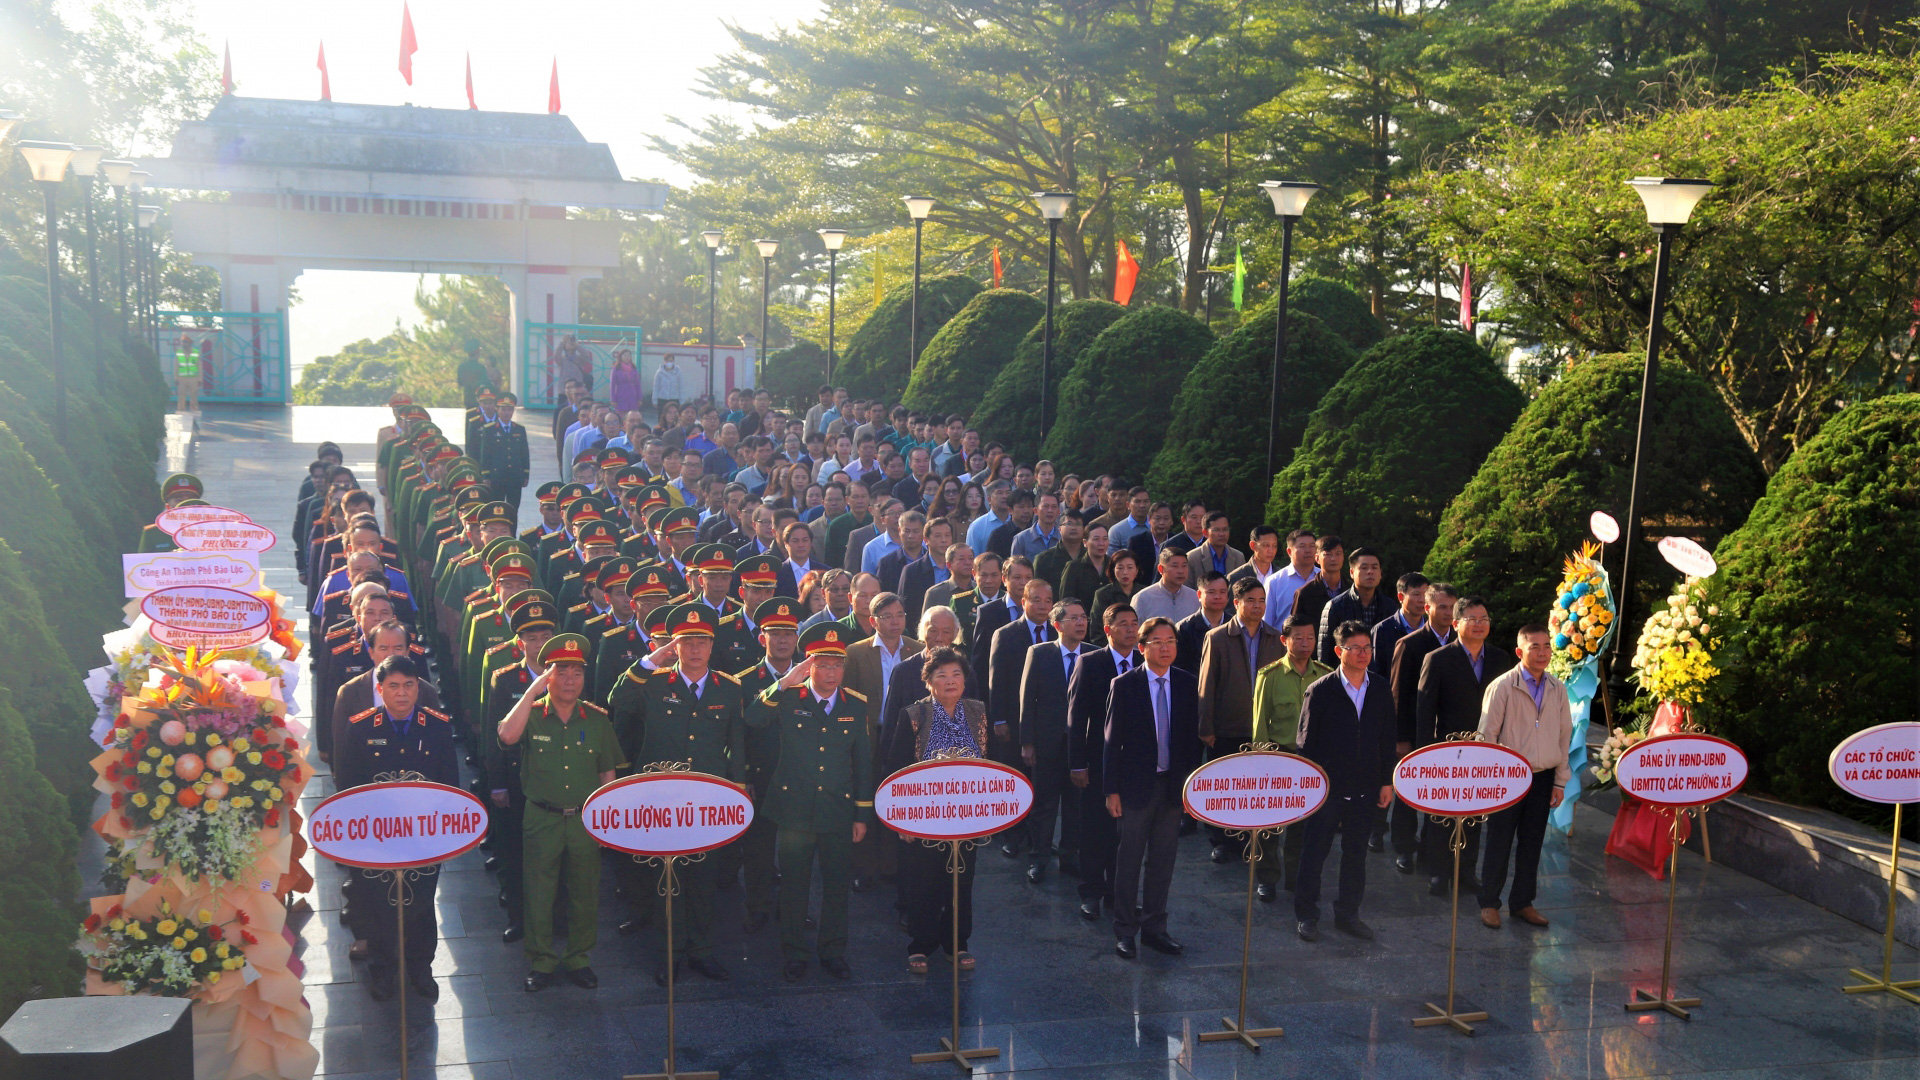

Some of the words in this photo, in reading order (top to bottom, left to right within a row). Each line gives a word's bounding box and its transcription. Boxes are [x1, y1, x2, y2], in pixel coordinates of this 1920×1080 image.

[240, 540, 248, 548] 2
[140, 568, 159, 578] Công
[1640, 749, 1662, 768] ĐẢNG
[1666, 749, 1676, 767] ỦY
[1679, 753, 1726, 766] HĐND-UBND
[1845, 750, 1865, 763] CÁC
[1870, 747, 1884, 762] TỔ
[1886, 748, 1915, 761] CHỨC
[1400, 764, 1417, 778] CÁC
[1420, 763, 1449, 778] PHÒNG
[1452, 766, 1469, 778] BAN
[1472, 763, 1504, 778] CHUYÊN
[1508, 763, 1527, 778] MÔN
[1845, 768, 1858, 780] VÀ
[1862, 767, 1882, 780] CÁC
[1886, 769, 1920, 779] DOANH
[892, 782, 943, 797] BMVNAH-LTCM
[946, 778, 959, 794] CÁC
[962, 781, 975, 794] Đ/C
[978, 777, 986, 793] LÀ
[989, 776, 1003, 793] CÁN
[1006, 775, 1015, 796] BỘ
[1193, 777, 1211, 791] LÃNH
[1214, 778, 1229, 794] ĐẠO
[1232, 774, 1256, 790] THÀNH
[1271, 777, 1292, 789] HĐND
[1300, 776, 1320, 789] UBND
[1632, 776, 1665, 792] UBMTTQ
[1668, 774, 1683, 790] CÁC
[1686, 773, 1719, 789] PHƯỜNG
[1721, 773, 1731, 788] XÃ
[1206, 798, 1236, 811] UBMTTQ
[1238, 794, 1248, 809] VÀ
[1250, 793, 1265, 809] CÁC
[1268, 797, 1283, 809] BAN
[1285, 792, 1305, 808] ĐẢNG
[1417, 785, 1428, 800] VÀ
[1431, 786, 1450, 800] ĐƠN
[1452, 788, 1460, 802] VỊ
[1463, 785, 1474, 802] SỰ
[1476, 784, 1507, 801] NGHIỆP
[593, 806, 620, 833] LỰC
[625, 805, 671, 832] LƯỢNG
[676, 802, 693, 827] VŨ
[699, 805, 745, 826] TRANG
[887, 804, 906, 820] LÃNH
[909, 806, 923, 823] ĐẠO
[926, 801, 940, 819] BẢO
[943, 802, 956, 821] LỘC
[959, 805, 972, 820] QUA
[975, 799, 989, 817] CÁC
[991, 800, 1007, 816] THỜI
[1010, 799, 1019, 815] KỲ
[312, 815, 343, 842] CÁC
[348, 815, 369, 840] CƠ
[373, 816, 412, 842] QUAN
[418, 811, 438, 836] TƯ
[442, 807, 481, 834] PHÁP
